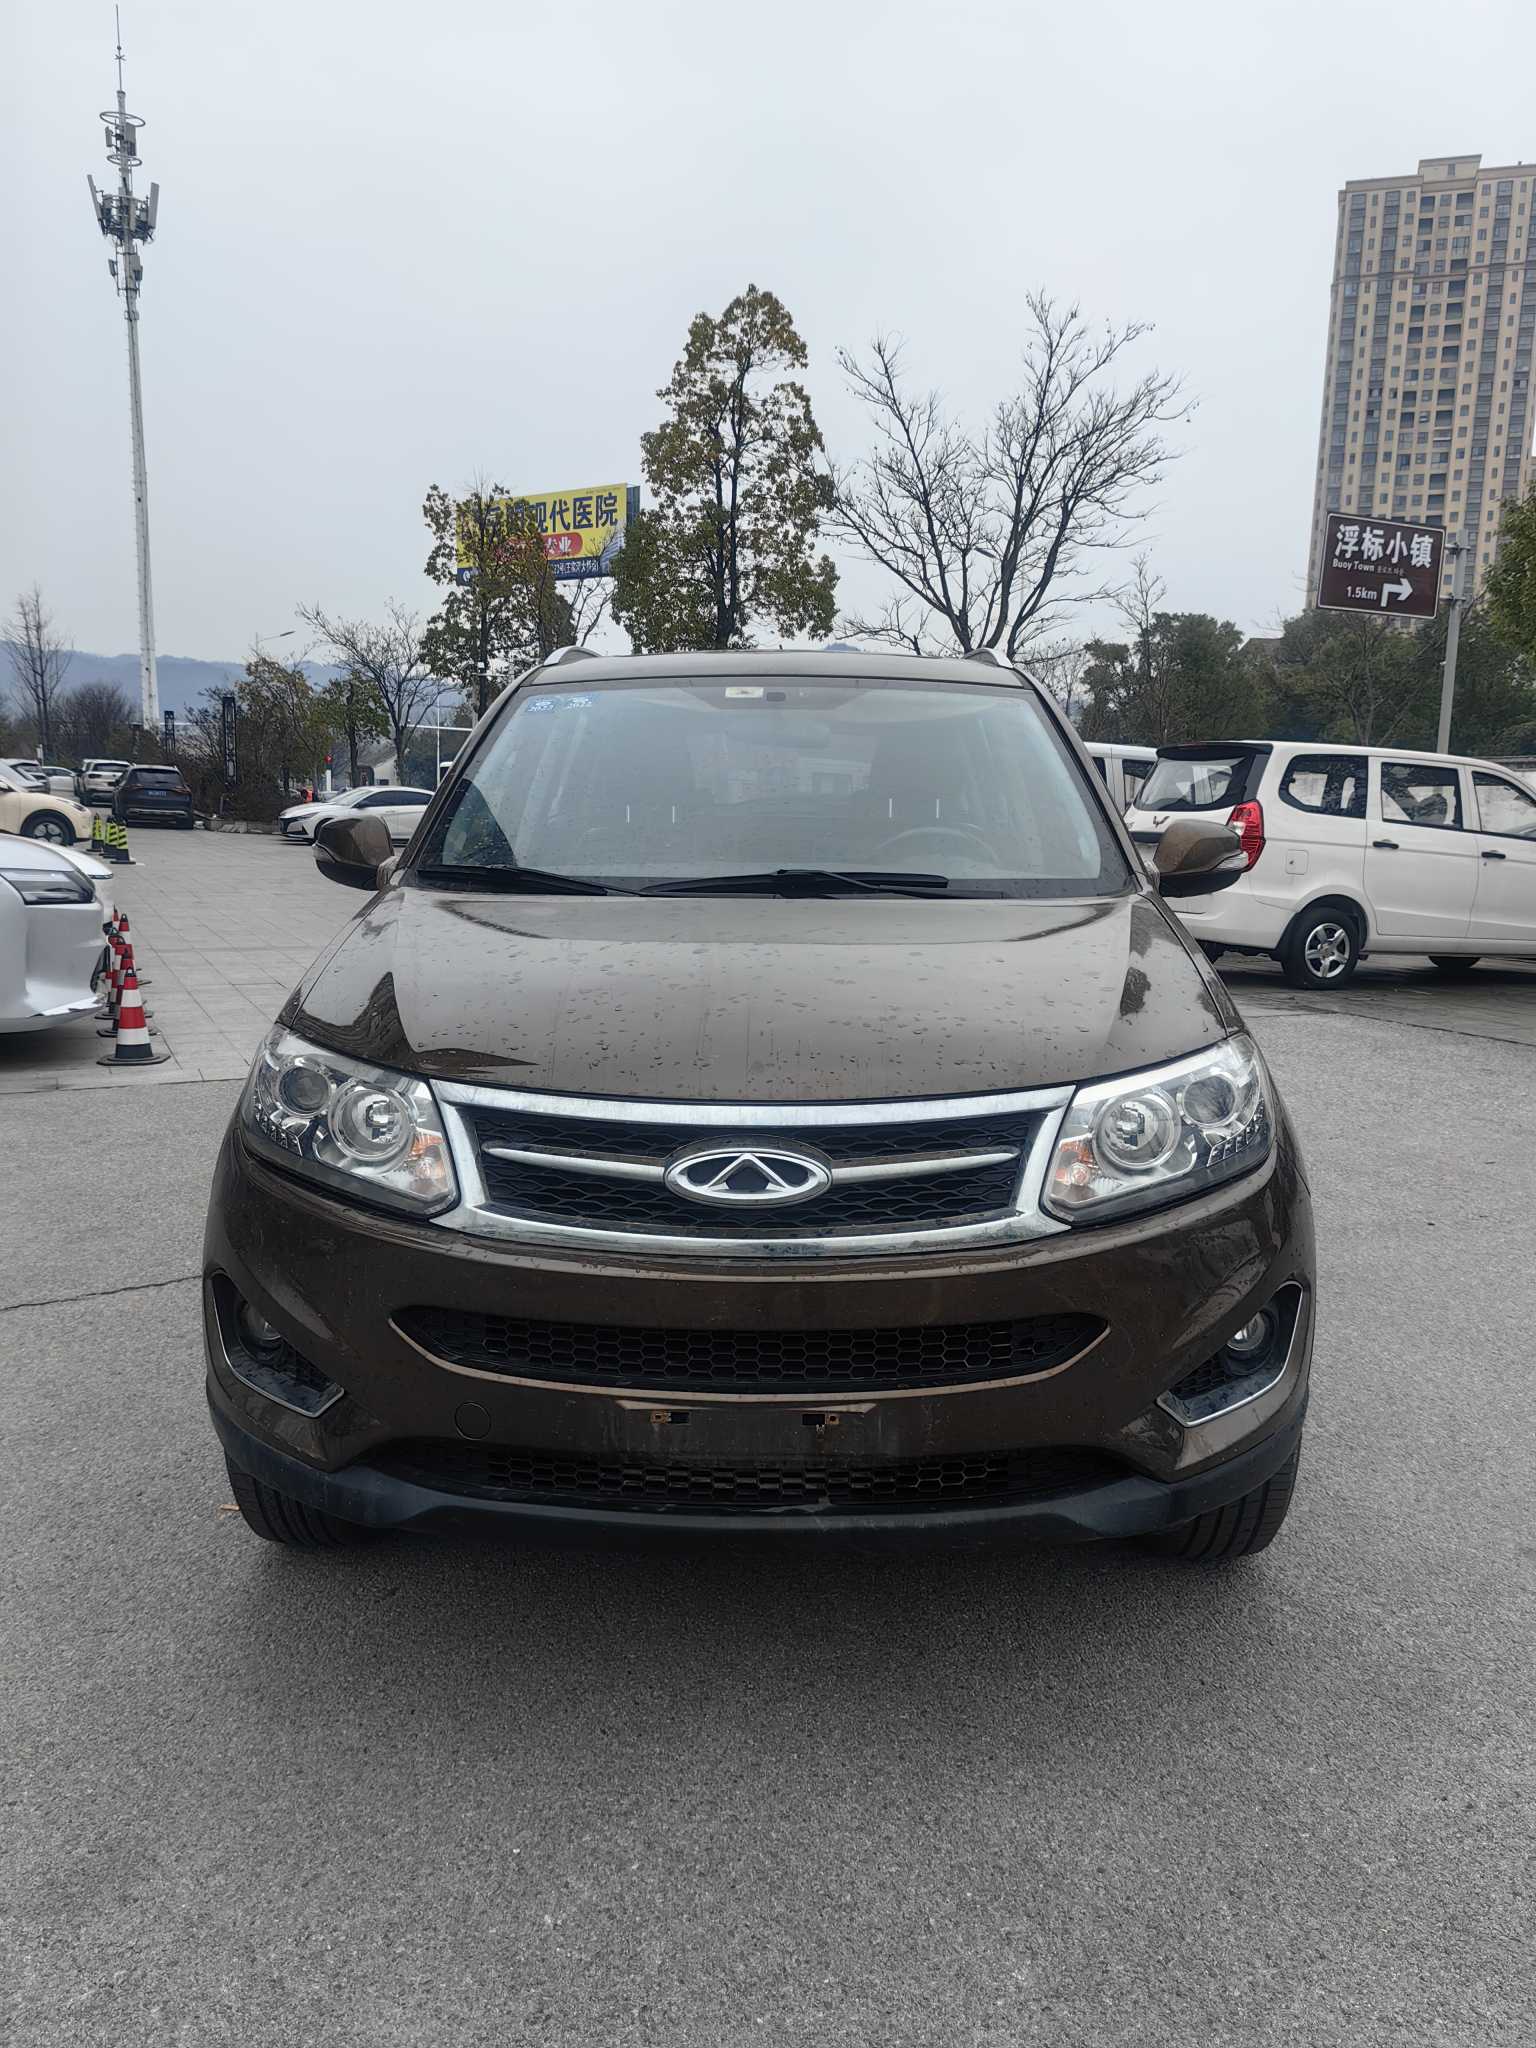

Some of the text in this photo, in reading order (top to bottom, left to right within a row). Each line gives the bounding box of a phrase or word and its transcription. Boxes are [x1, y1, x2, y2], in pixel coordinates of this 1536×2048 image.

[1334, 524, 1434, 568] 浮标小镇
[1333, 558, 1375, 571] Buoy Town
[1346, 585, 1377, 600] 1.5km
